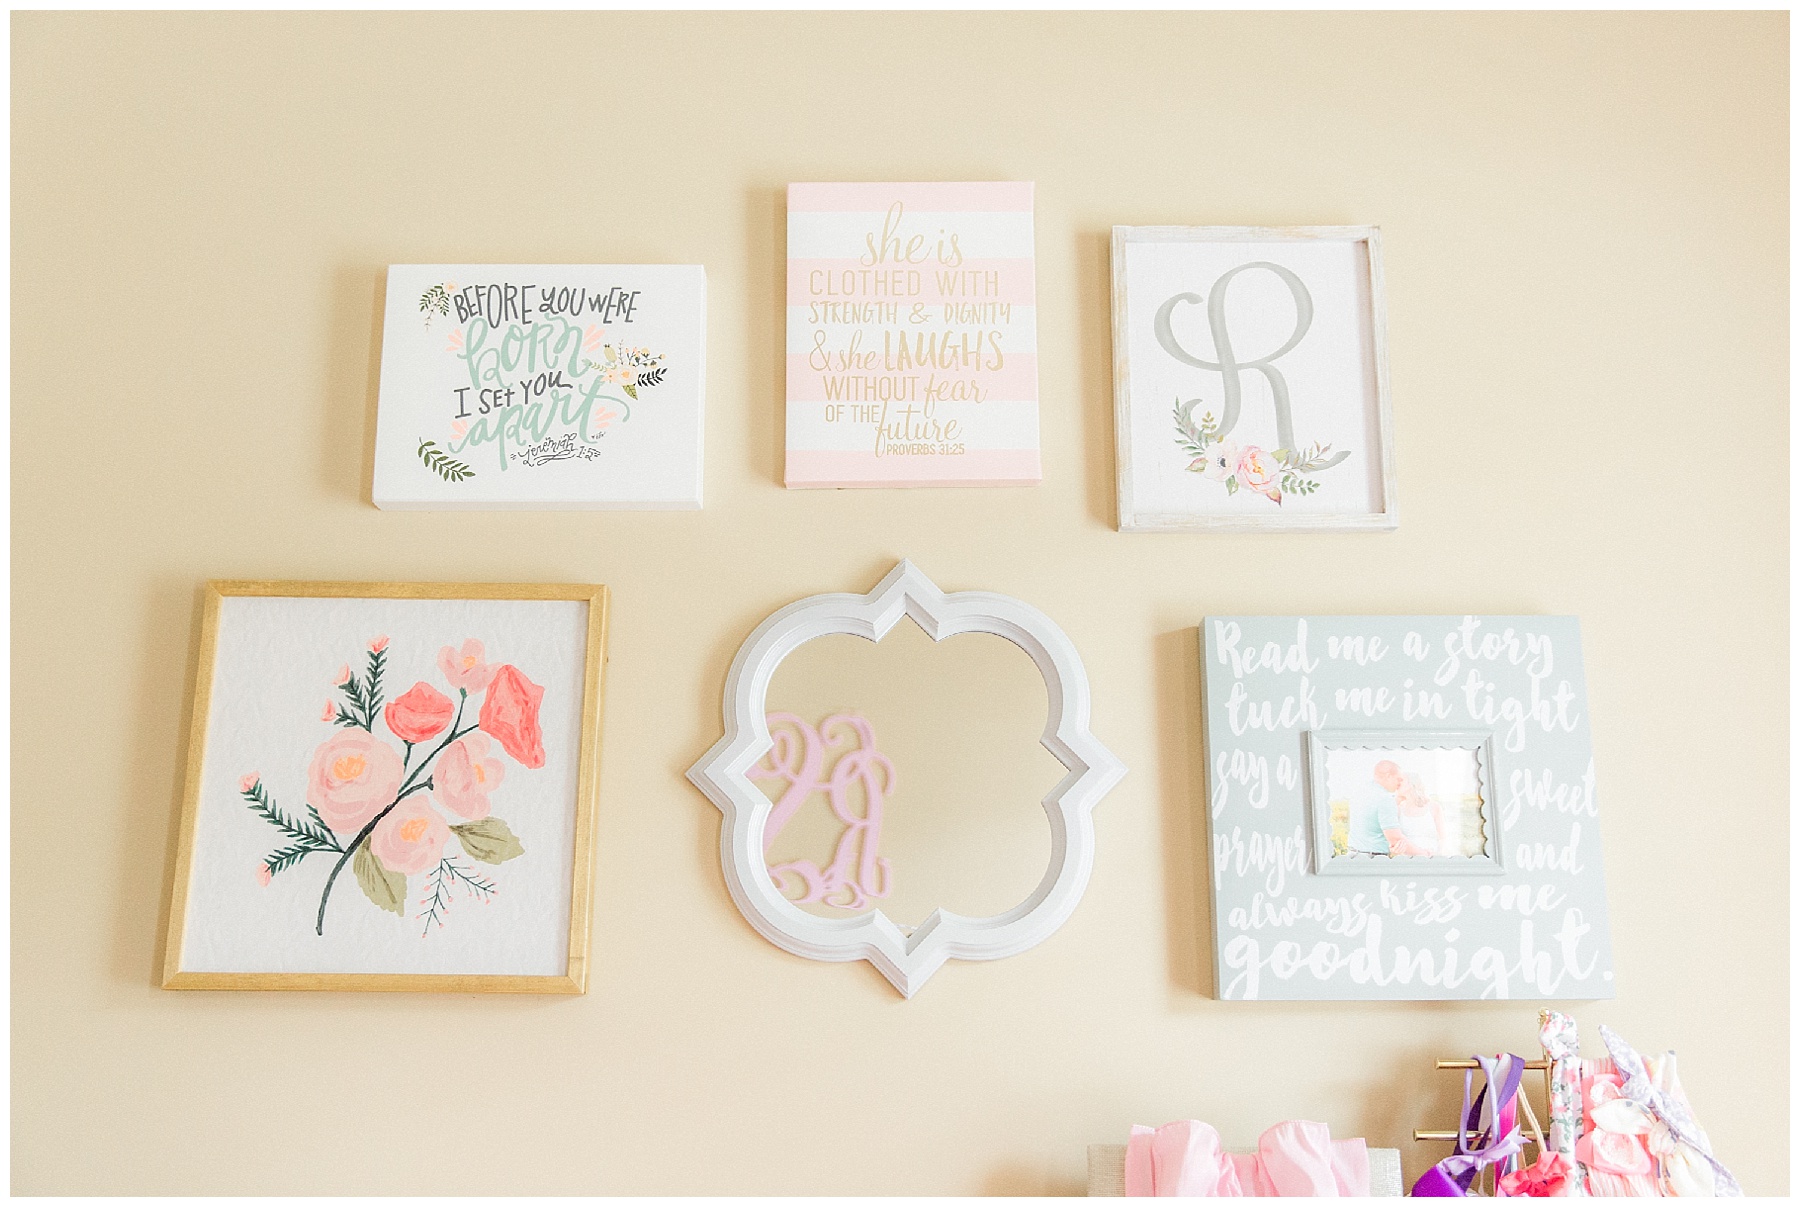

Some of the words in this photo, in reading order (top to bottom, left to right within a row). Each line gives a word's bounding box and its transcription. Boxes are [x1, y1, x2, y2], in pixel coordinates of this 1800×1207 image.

[860, 201, 932, 267] she
[937, 229, 963, 268] is
[453, 282, 536, 328] BEFORE
[589, 287, 641, 323] WERE
[809, 269, 921, 297] CLOTHED
[935, 270, 999, 297] WITH
[808, 300, 898, 325] STRENGTH
[908, 302, 933, 324] &
[944, 302, 1011, 325] DIGNITY
[809, 329, 831, 372] &
[835, 329, 881, 372] she
[884, 330, 1004, 372] LAUGHS
[1153, 261, 1351, 474] R
[448, 375, 630, 471] apart
[454, 387, 472, 419] I
[823, 375, 920, 401] WITHOUT
[923, 373, 988, 419] fear
[825, 404, 844, 422] OF
[851, 404, 880, 423] THE
[875, 400, 962, 458] future
[886, 443, 935, 456] PROVERBS
[938, 443, 965, 456] 31:25
[1214, 617, 1319, 678] Read
[1327, 634, 1389, 666] me
[1402, 631, 1430, 661] a
[1434, 615, 1554, 686] story
[1225, 675, 1327, 736] tuck
[1335, 685, 1397, 716] me
[1402, 678, 1453, 722] in
[1461, 669, 1580, 752] tight
[1211, 749, 1269, 820] say
[1276, 754, 1298, 791] a
[1503, 756, 1599, 831] sweet
[1213, 825, 1312, 897] prayer
[1516, 822, 1584, 875] and
[1228, 892, 1373, 937] always
[1380, 879, 1469, 924] kiss
[1477, 884, 1566, 915] me
[1224, 908, 1613, 999] goodnight.
